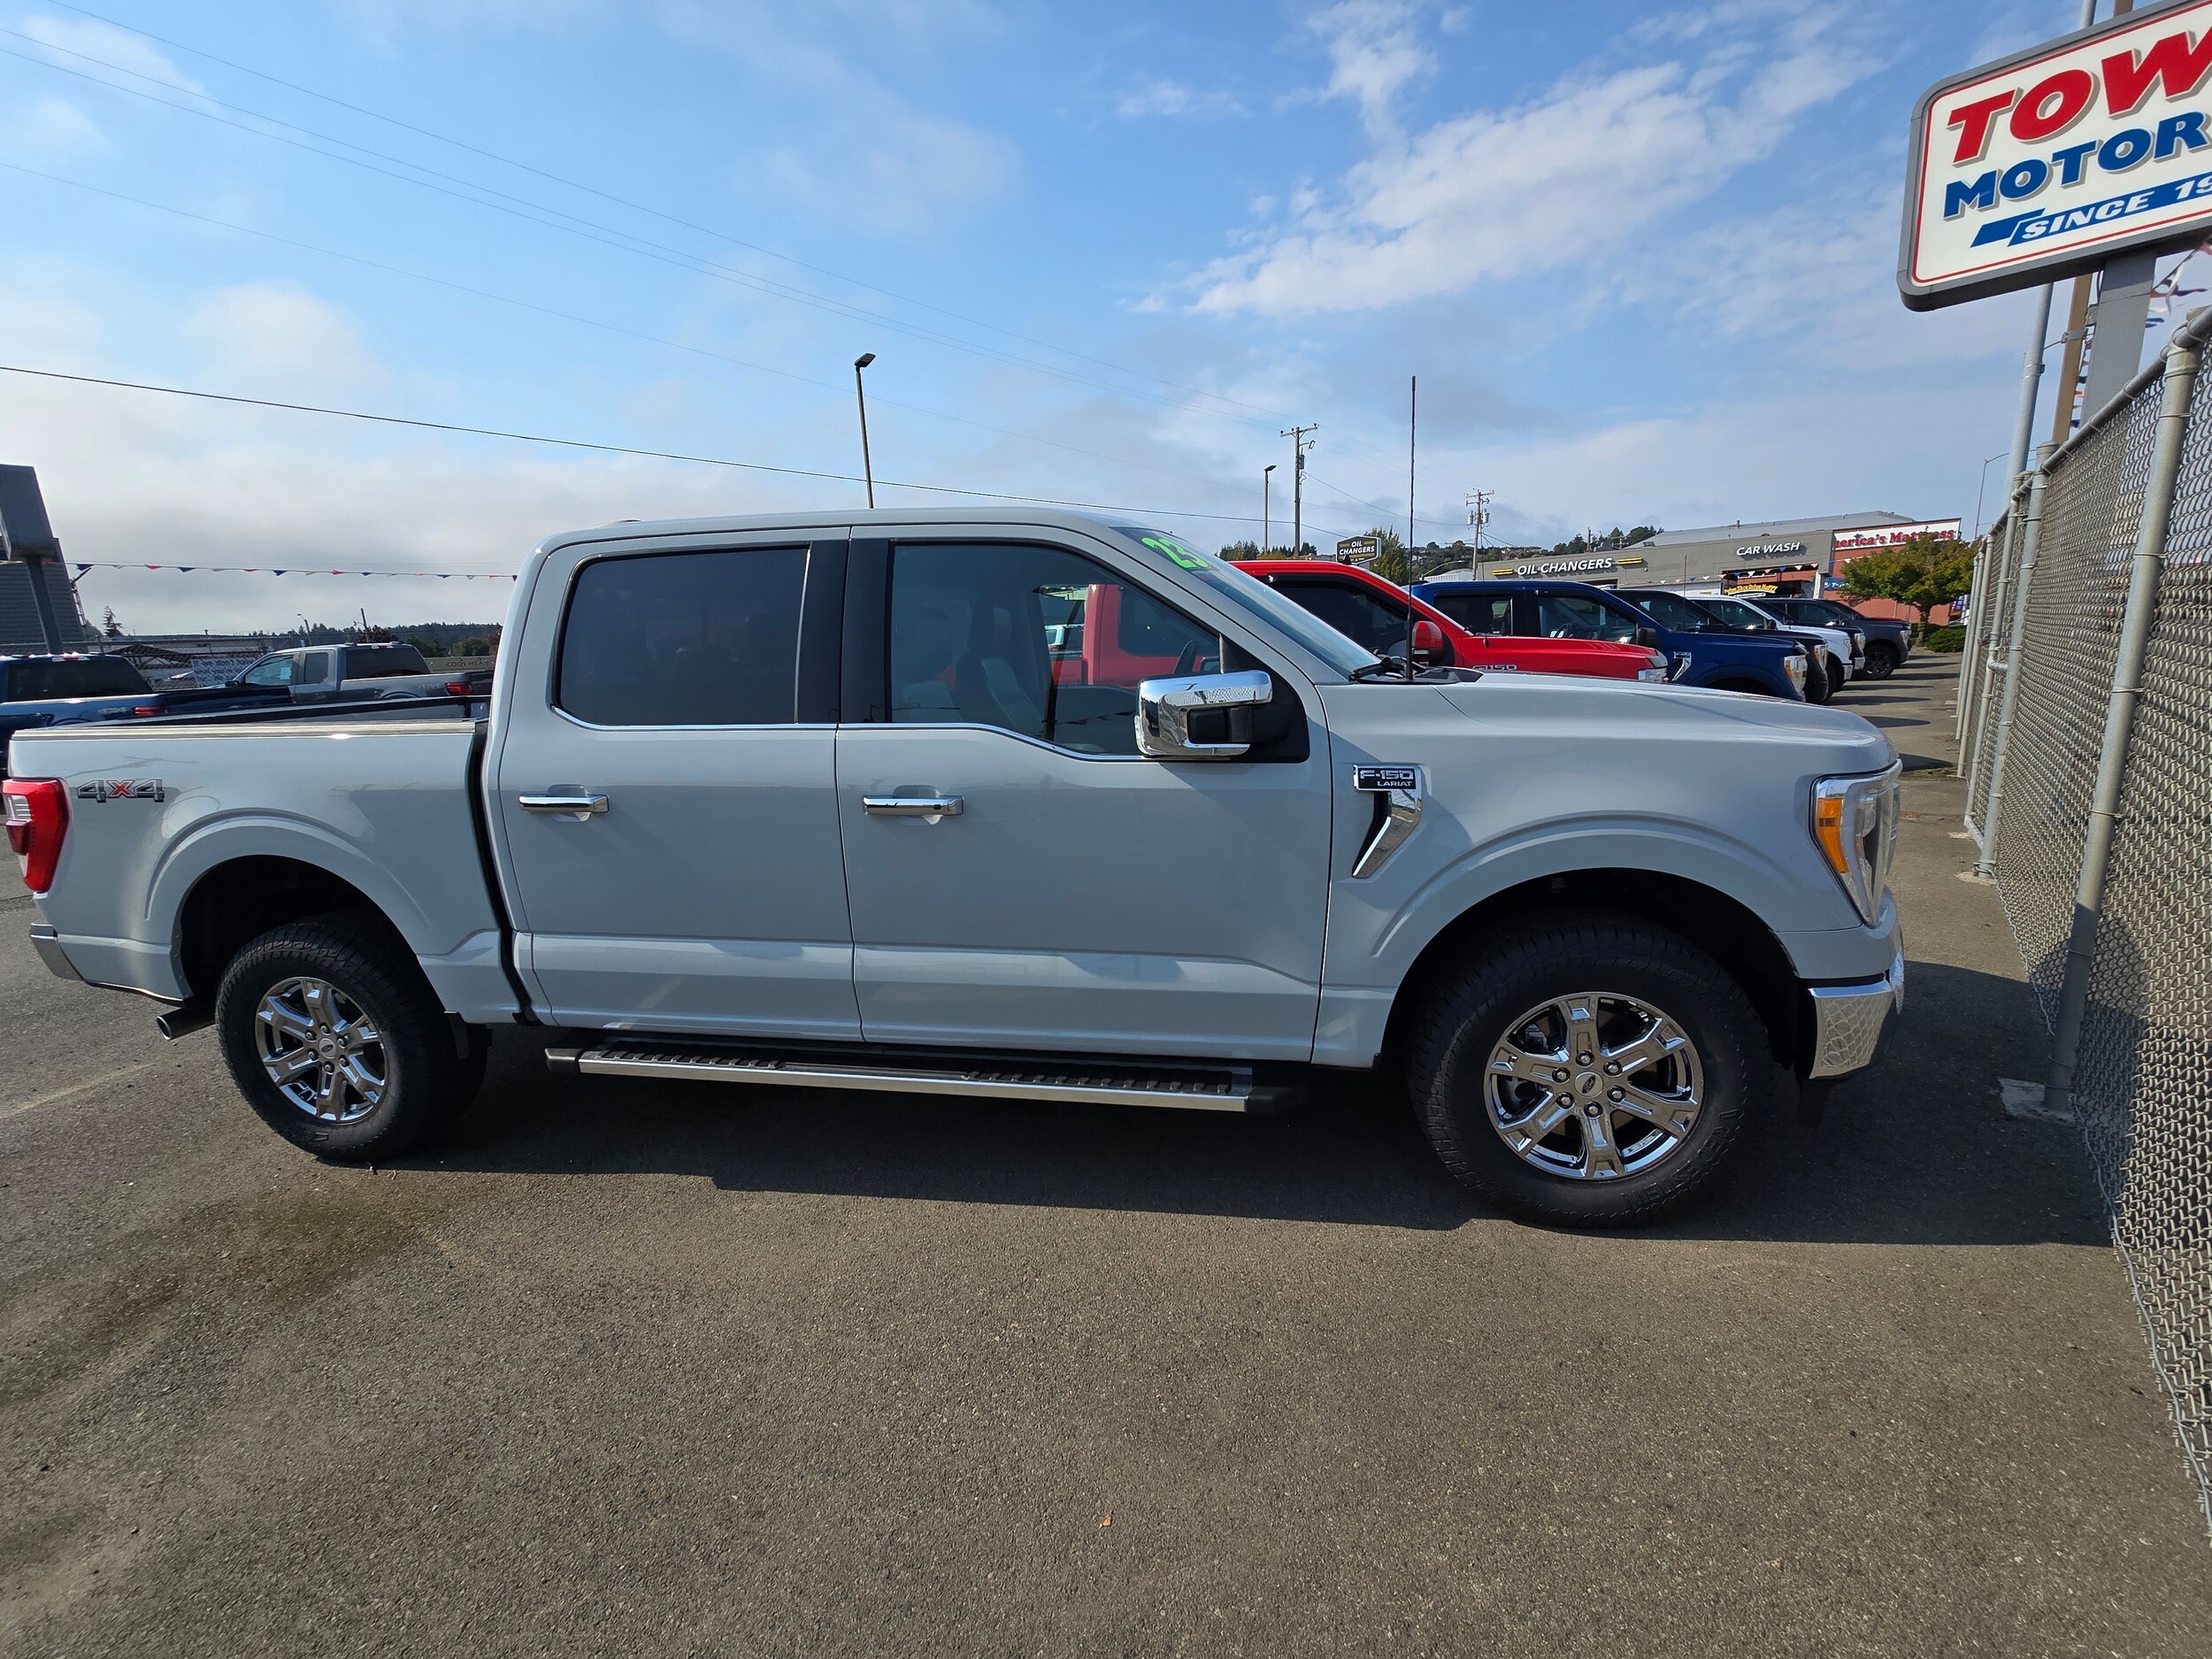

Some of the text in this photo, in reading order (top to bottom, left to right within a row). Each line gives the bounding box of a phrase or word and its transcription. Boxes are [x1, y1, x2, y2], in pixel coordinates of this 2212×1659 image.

[1943, 110, 2208, 219] MOTOR
[2022, 192, 2151, 240] SINCE
[1141, 537, 1210, 569] 23
[1339, 546, 1375, 556] CHANGERS
[1736, 541, 1801, 557] CAR WASH
[1517, 557, 1613, 575] OIL CHANGERS
[1360, 770, 1414, 780] F-150
